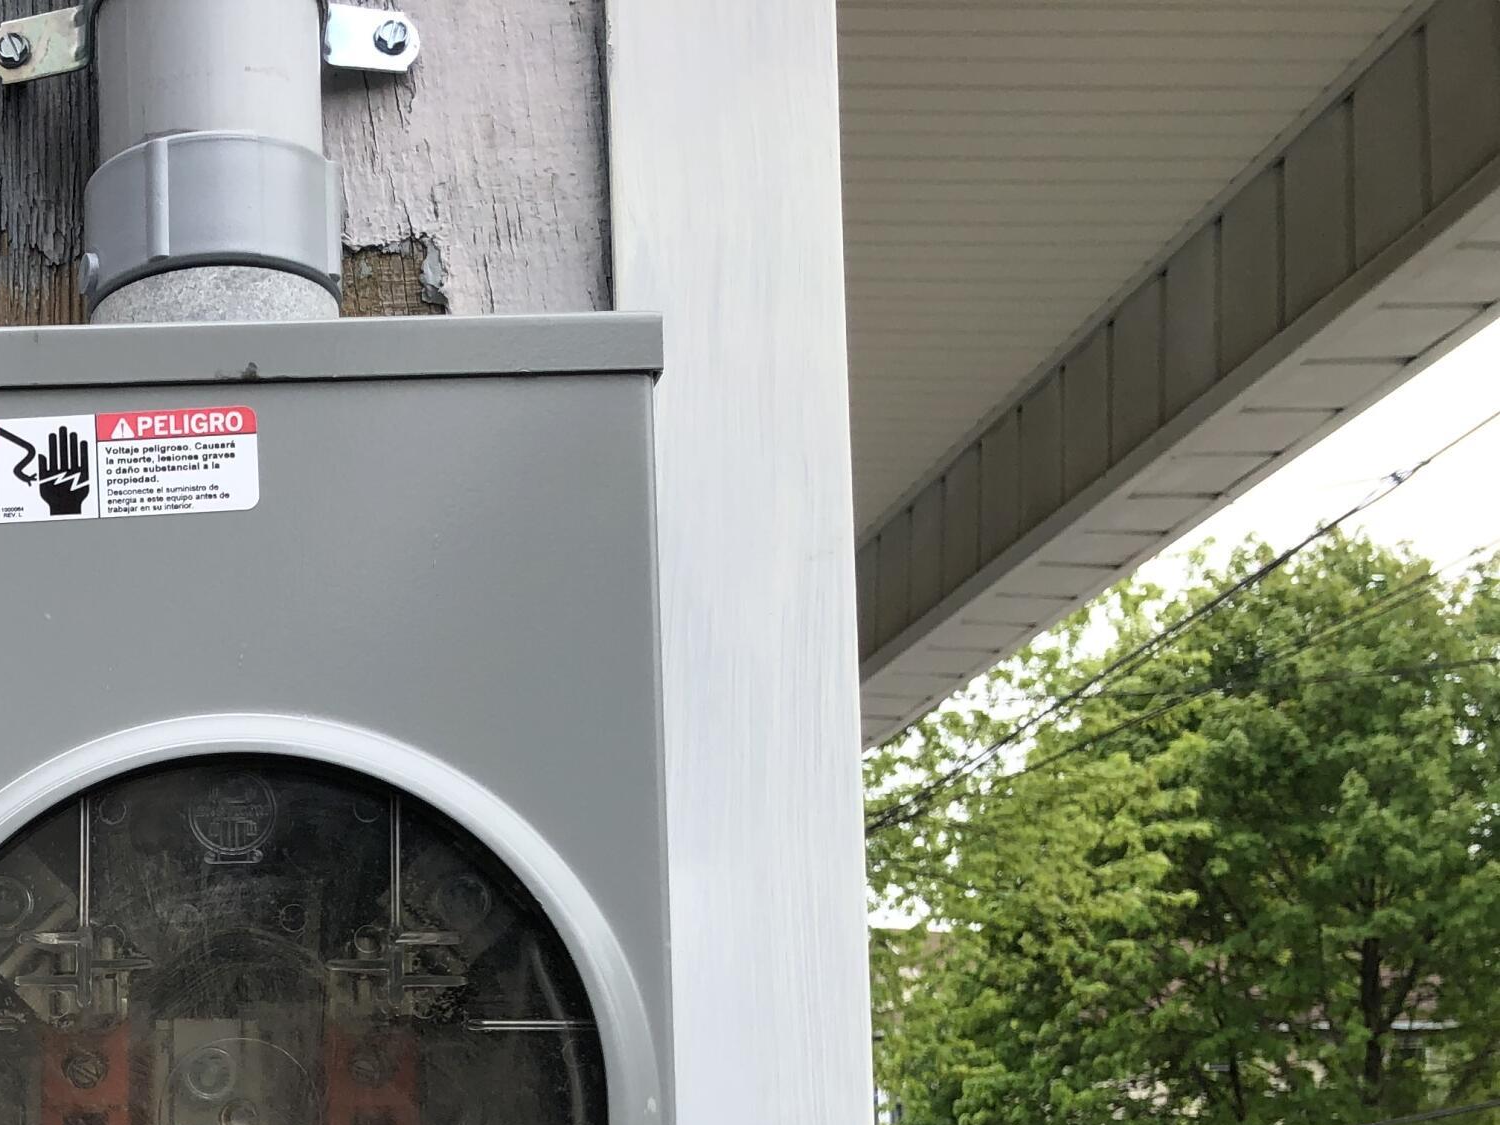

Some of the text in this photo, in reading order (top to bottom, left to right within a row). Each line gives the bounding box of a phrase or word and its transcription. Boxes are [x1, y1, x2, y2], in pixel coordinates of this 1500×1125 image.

[137, 411, 243, 436] PELIGRO
[105, 440, 235, 456] Voltaje peligroso. Causará
[106, 452, 235, 465] la muerte, lesiones graves
[115, 465, 140, 474] daño
[143, 462, 200, 473] substancial
[211, 461, 220, 470] la
[107, 475, 159, 487] propiedad.
[107, 483, 219, 496] Desconecte el suministro de
[166, 494, 193, 504] equipo
[196, 492, 217, 500] antes
[219, 491, 230, 499] de
[107, 506, 138, 514] trabajar
[164, 502, 194, 510] interior.
